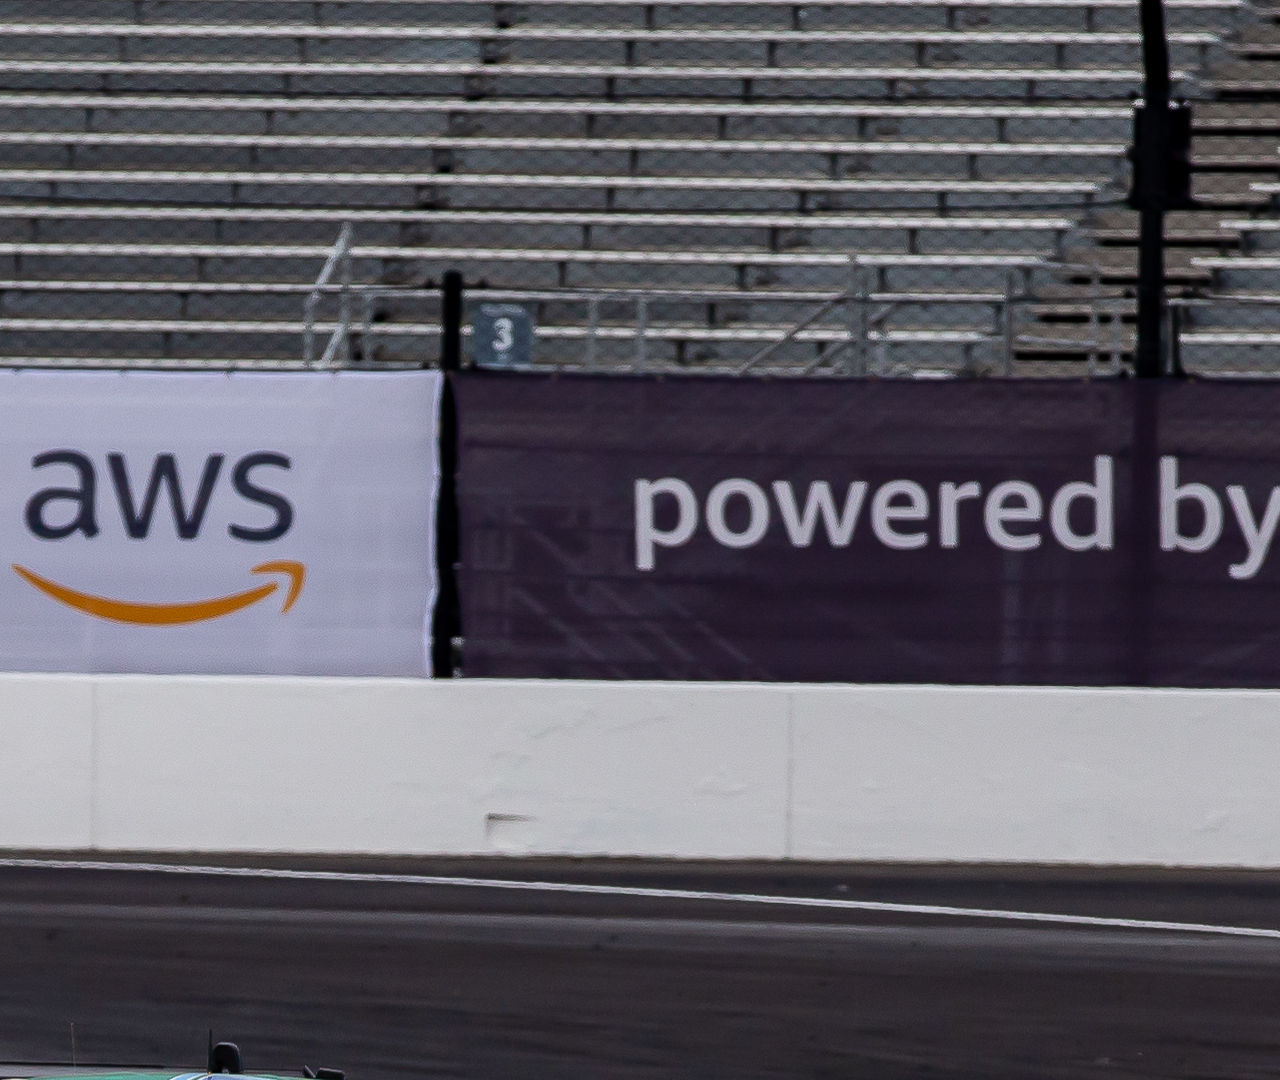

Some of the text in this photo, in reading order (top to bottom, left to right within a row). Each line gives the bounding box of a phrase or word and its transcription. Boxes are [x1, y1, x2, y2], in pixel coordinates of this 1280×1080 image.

[492, 318, 514, 351] 3
[24, 449, 294, 542] aws
[634, 454, 1114, 571] powered
